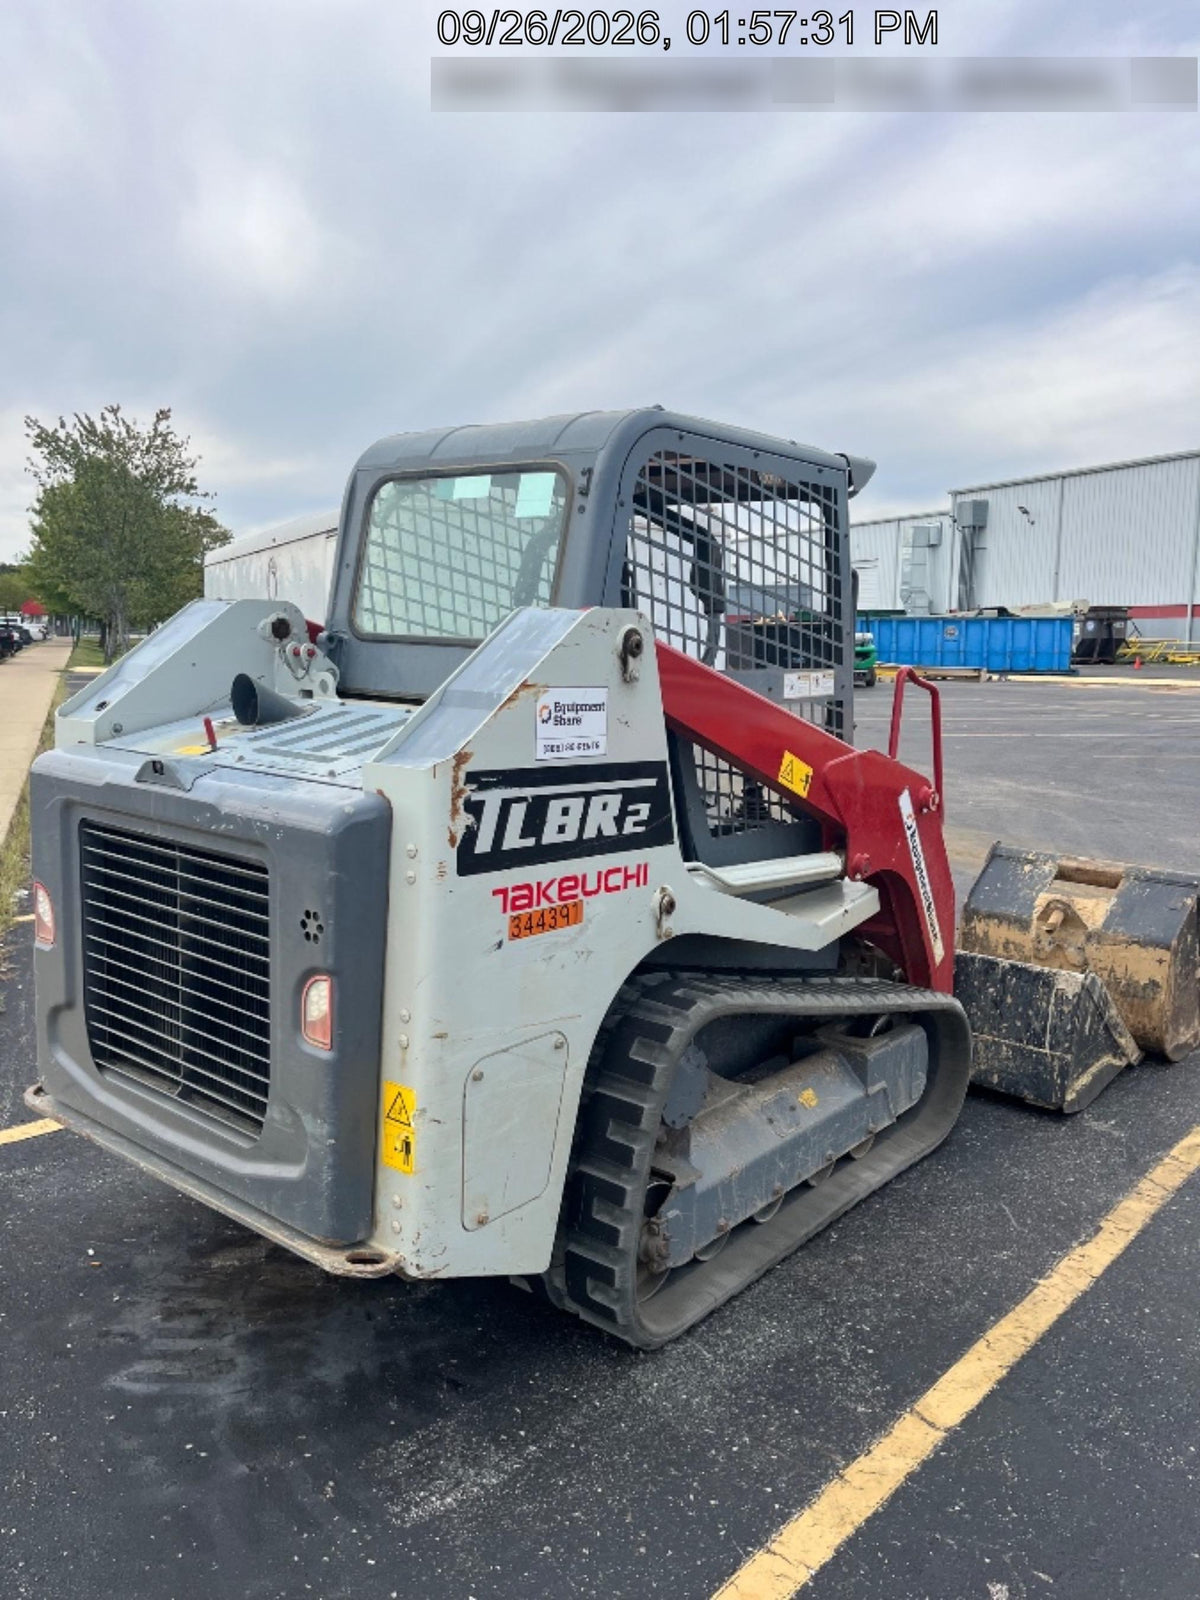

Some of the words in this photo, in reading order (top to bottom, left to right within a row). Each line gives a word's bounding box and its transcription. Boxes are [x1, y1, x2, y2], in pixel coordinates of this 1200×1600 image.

[553, 701, 605, 715] Equipment
[553, 715, 582, 726] Share
[510, 901, 580, 938] 344391
